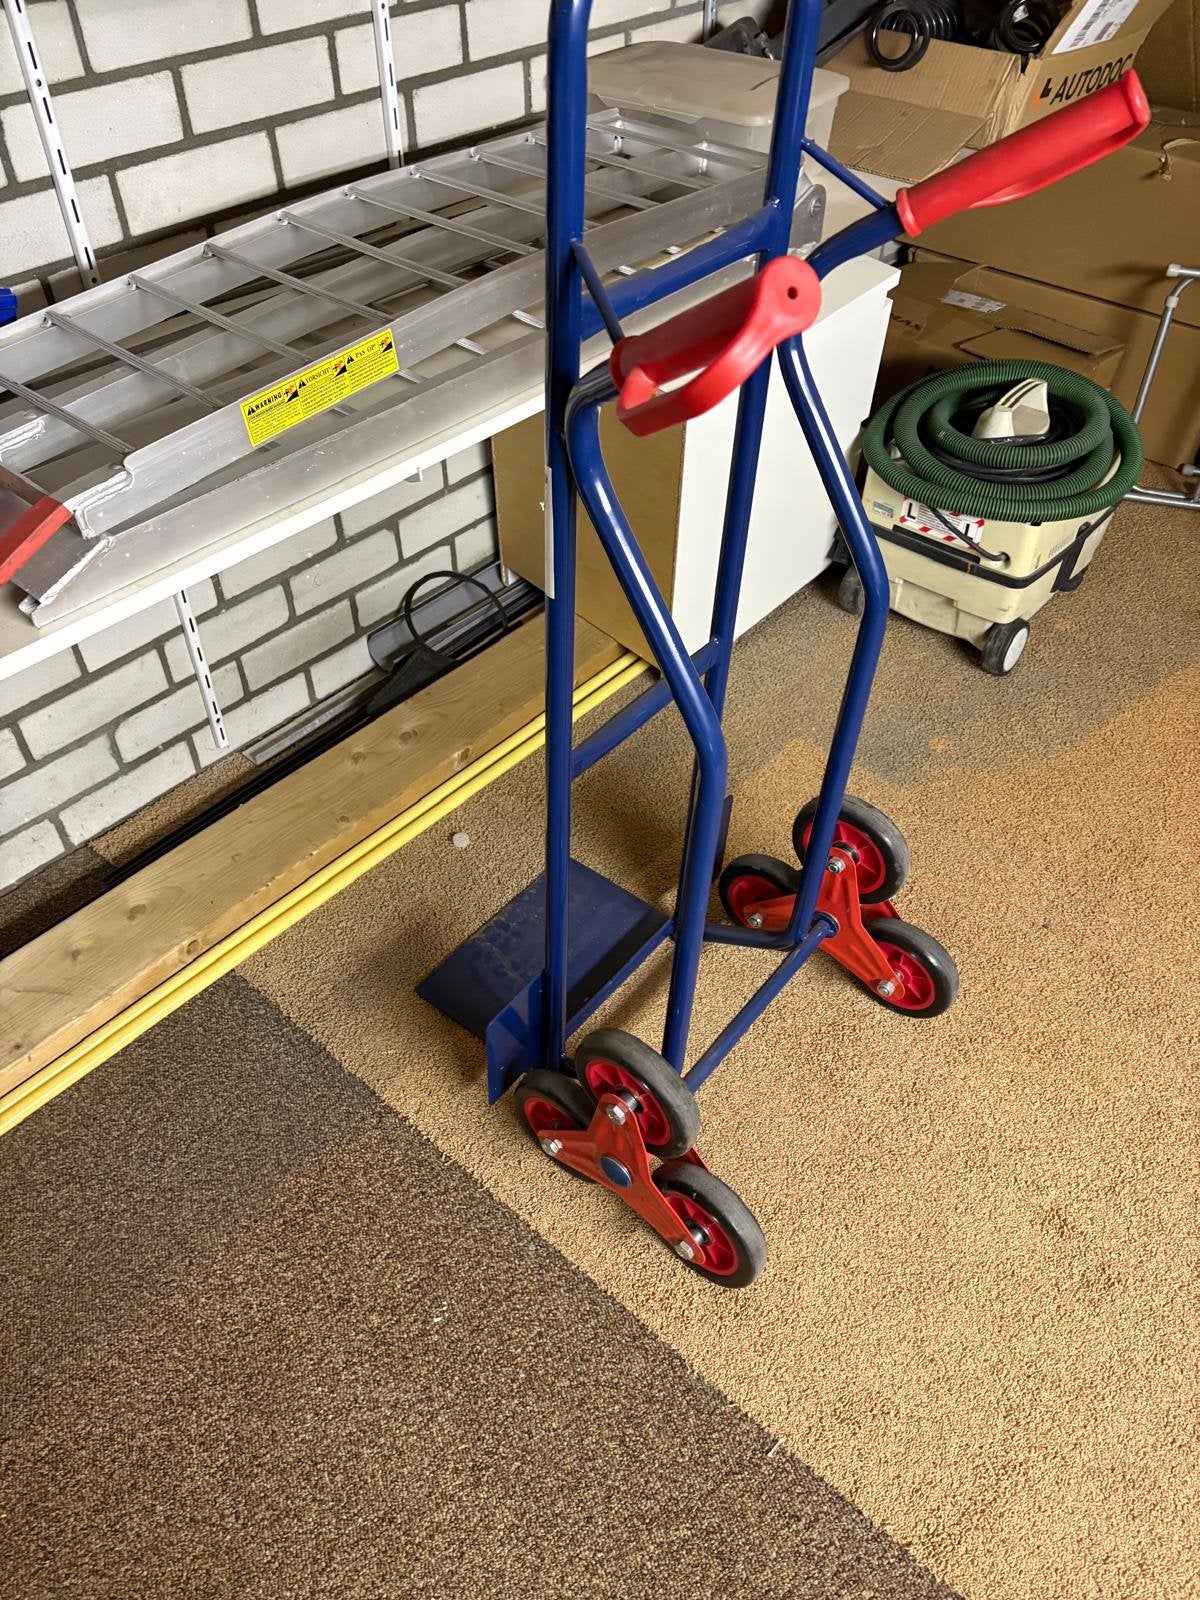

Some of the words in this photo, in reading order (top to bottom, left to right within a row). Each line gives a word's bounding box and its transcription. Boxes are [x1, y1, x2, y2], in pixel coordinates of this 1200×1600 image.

[1050, 53, 1133, 105] AUTODOC
[255, 392, 282, 410] WARNING
[907, 503, 916, 520] L
